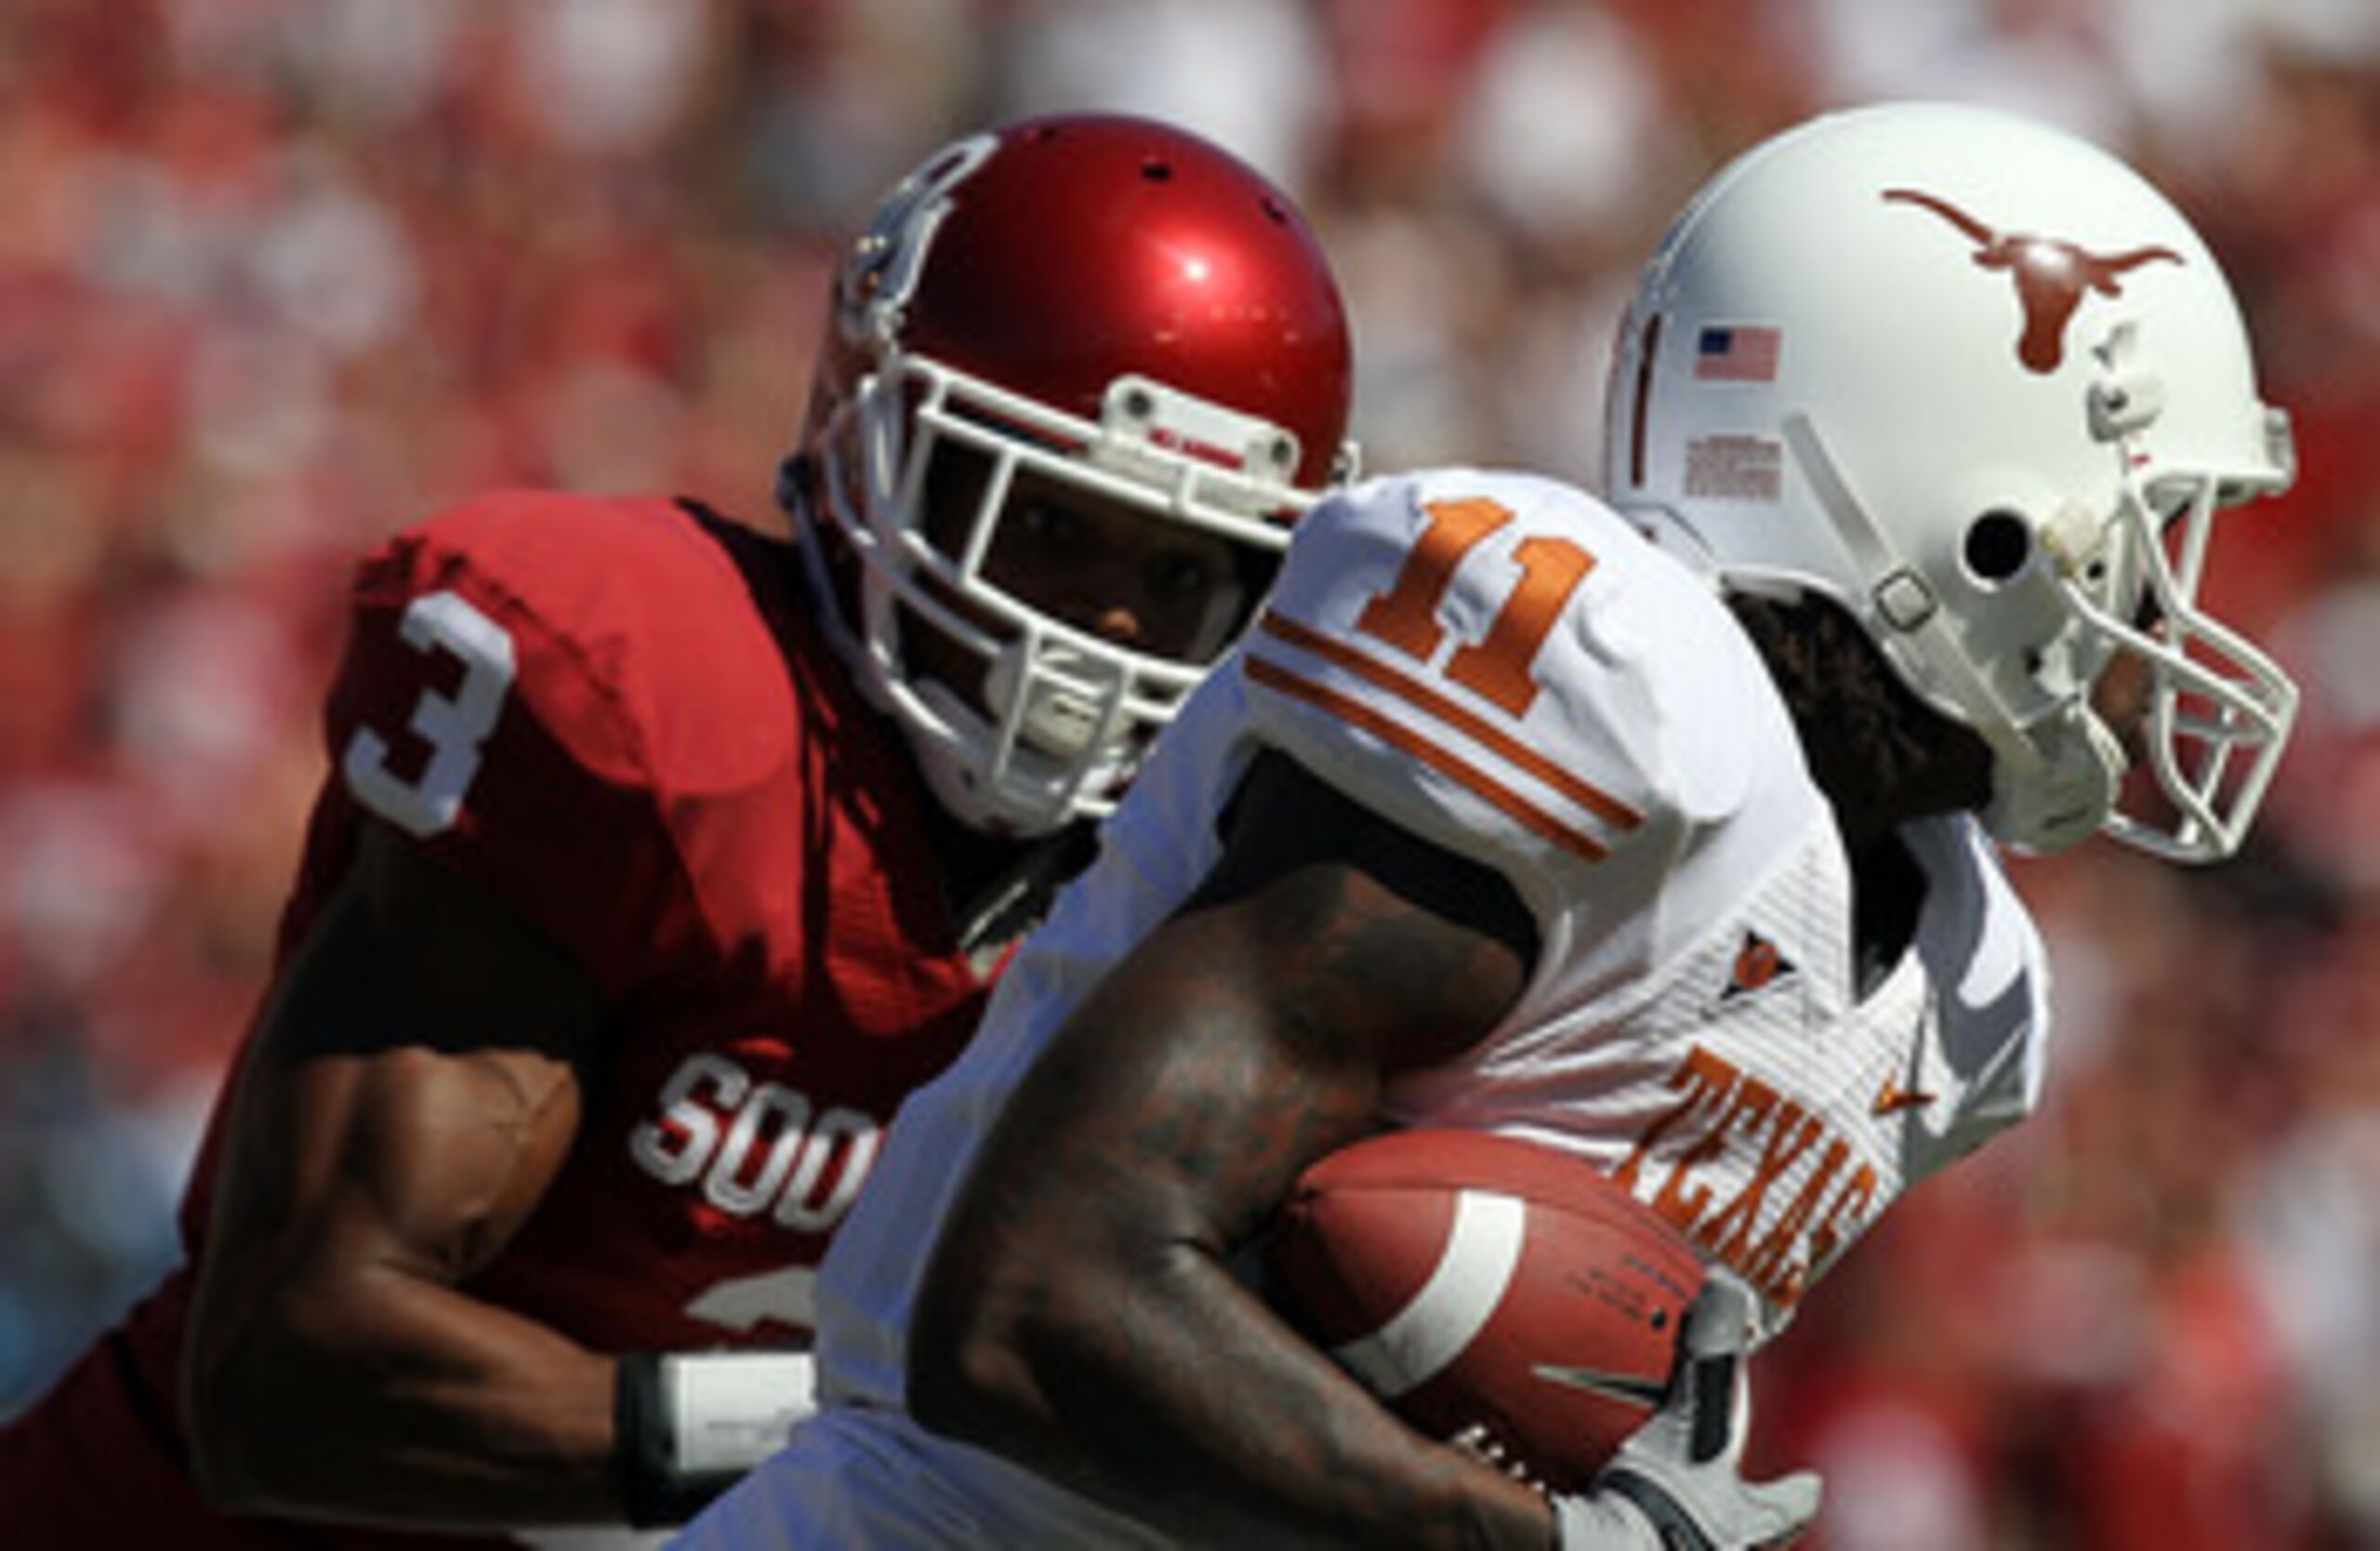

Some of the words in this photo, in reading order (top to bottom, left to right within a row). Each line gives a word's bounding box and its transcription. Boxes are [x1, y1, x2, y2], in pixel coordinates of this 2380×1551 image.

[344, 591, 517, 836] 3
[1356, 497, 1596, 722] 11
[1613, 1044, 1876, 1306] TEXAS
